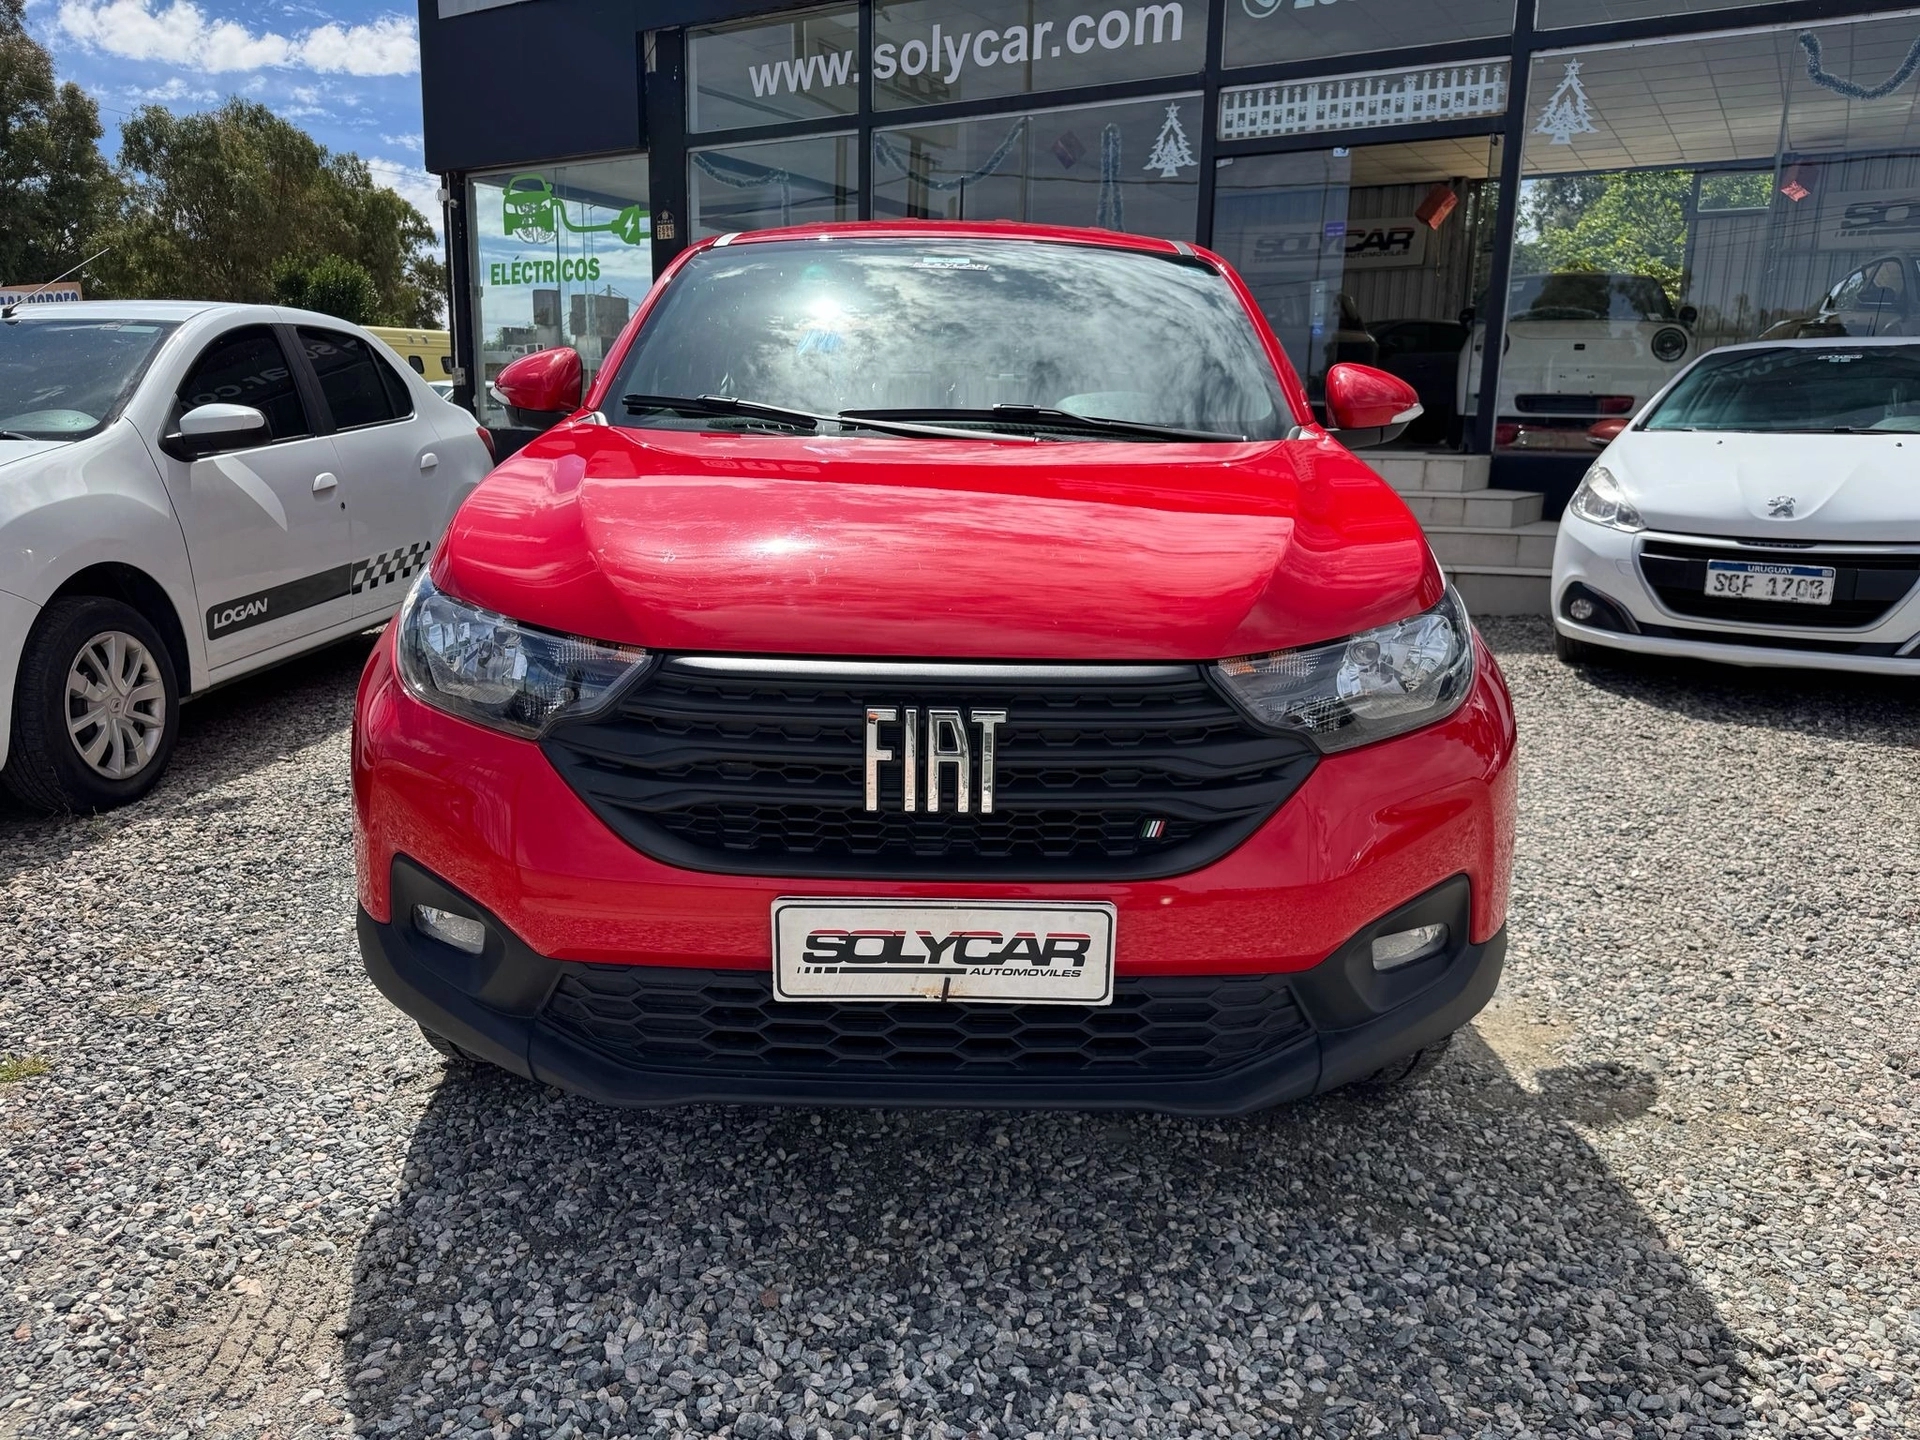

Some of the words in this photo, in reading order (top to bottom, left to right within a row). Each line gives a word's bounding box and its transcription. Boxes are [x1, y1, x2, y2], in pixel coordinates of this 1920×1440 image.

[749, 2, 1184, 98] www.solycar.com
[490, 255, 600, 286] ELÉCTRICOS
[1713, 573, 1755, 593] SCF
[1747, 565, 1794, 575] URUGUAY
[214, 597, 268, 630] LOGAN
[866, 708, 1007, 814] FIAT
[802, 929, 1091, 967] SOLYCAR
[969, 968, 1082, 978] AUTOMOVILES
